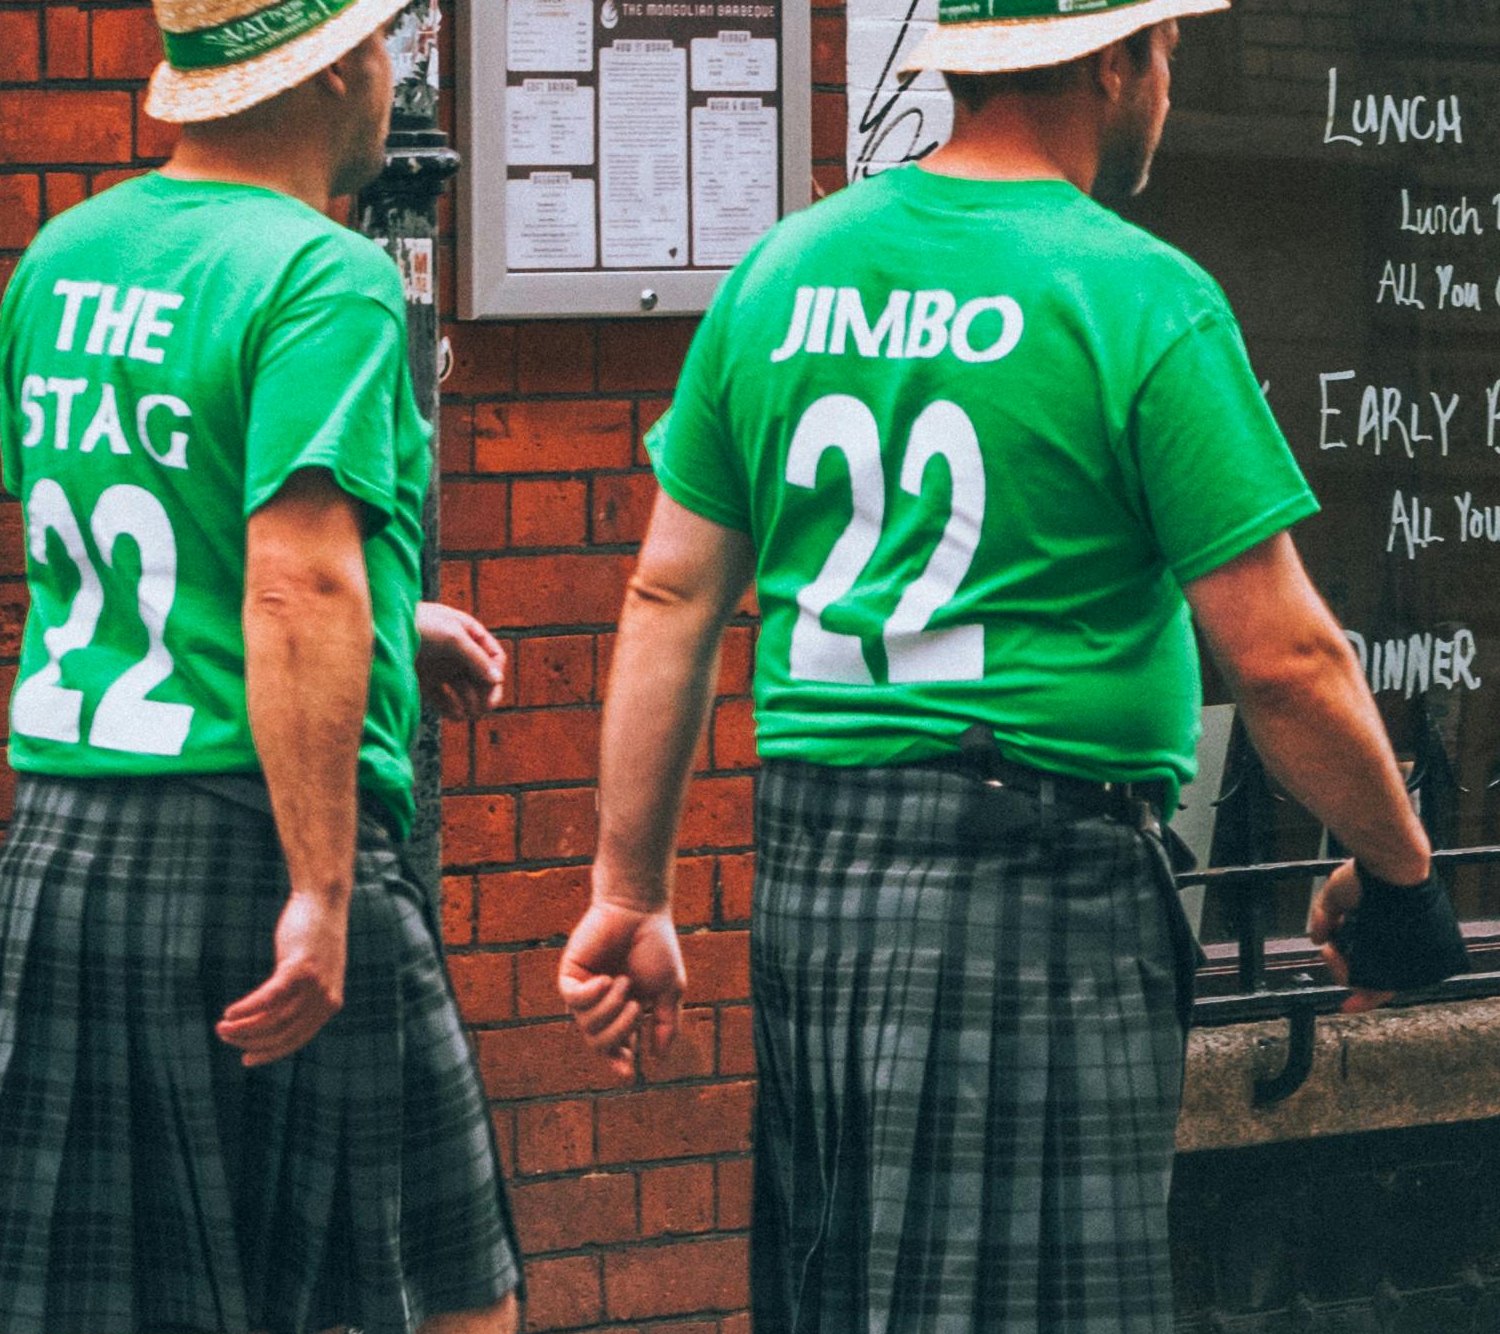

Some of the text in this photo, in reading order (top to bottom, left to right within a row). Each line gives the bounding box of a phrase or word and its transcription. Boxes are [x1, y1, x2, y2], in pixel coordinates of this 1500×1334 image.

[622, 2, 776, 19] THE MONGOLIAN BARBEQUE
[1323, 67, 1463, 147] LUNCH
[52, 280, 184, 365] THE
[770, 285, 1025, 365] JIMBO
[21, 373, 192, 470] STAG
[1319, 368, 1460, 459] EARLY
[784, 393, 987, 686] 22
[11, 476, 196, 757] 22
